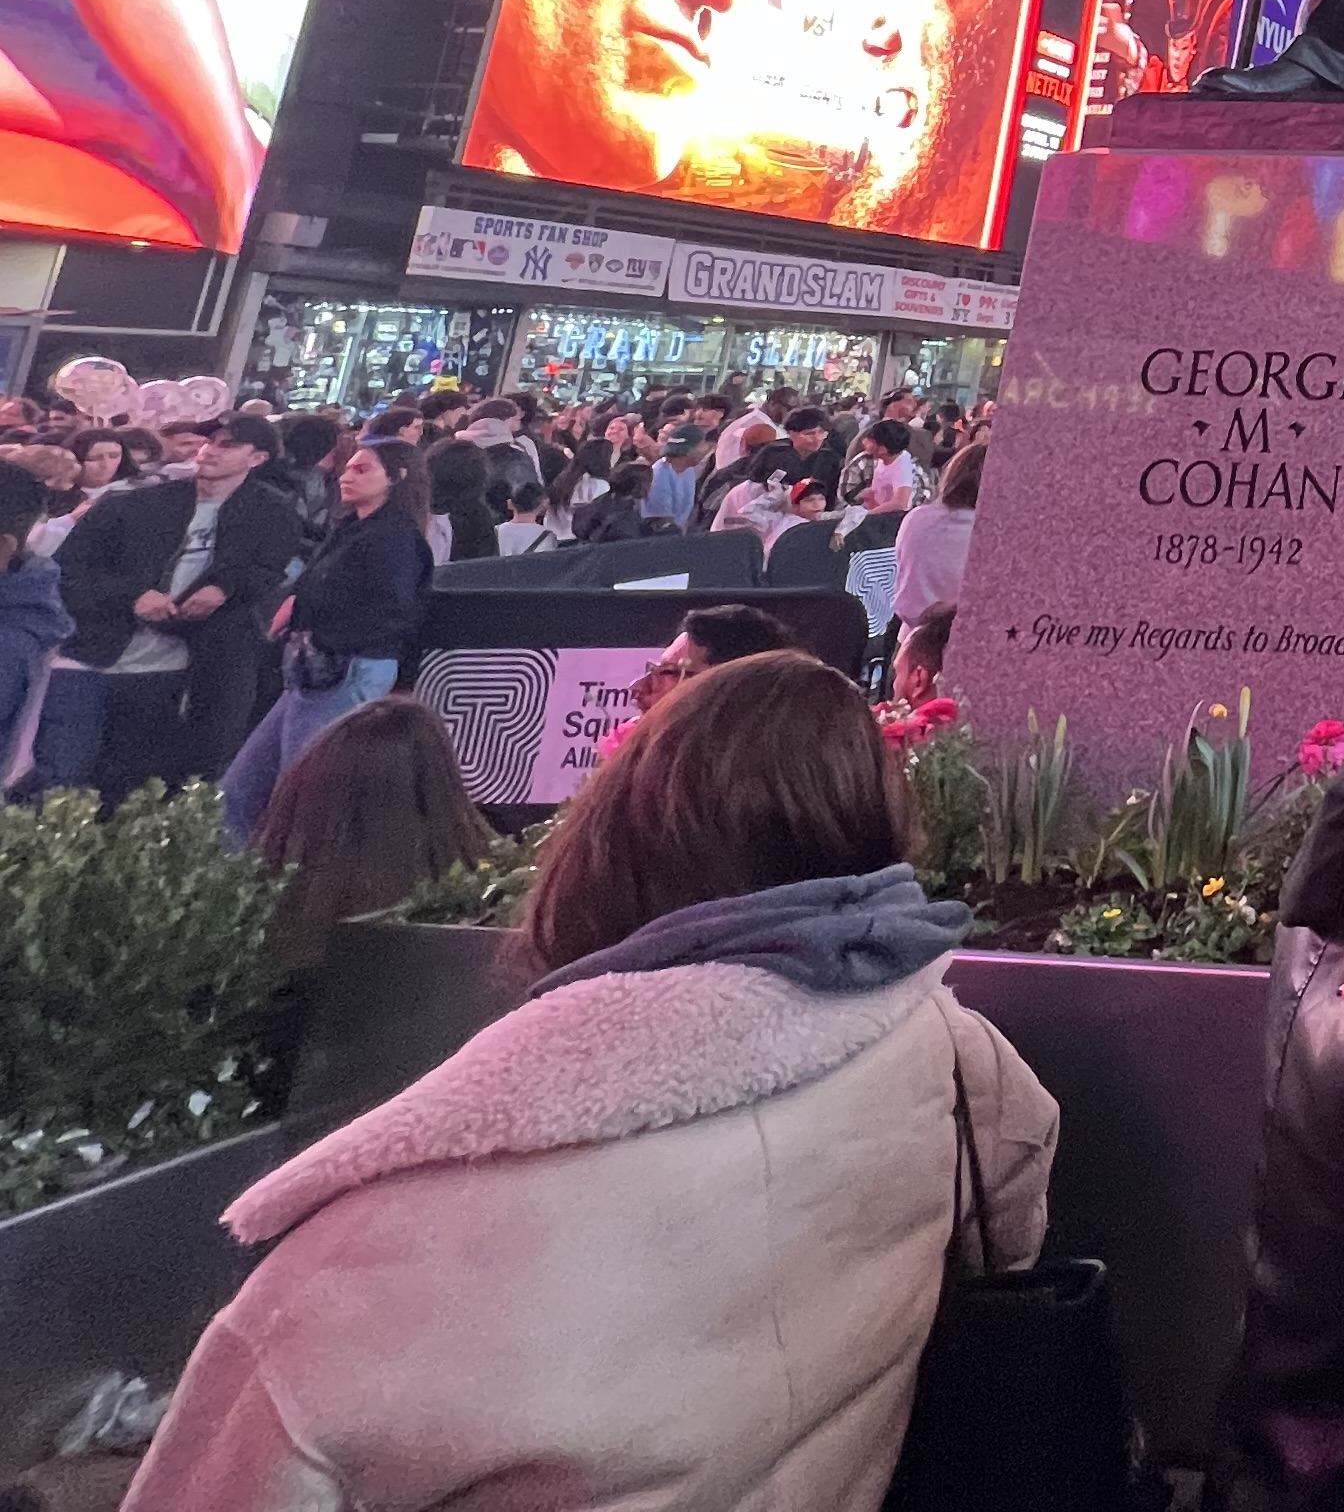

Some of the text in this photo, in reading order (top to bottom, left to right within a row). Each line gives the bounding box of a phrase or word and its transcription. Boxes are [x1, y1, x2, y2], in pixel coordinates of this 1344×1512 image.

[1026, 70, 1075, 107] NETFLIX
[473, 215, 609, 249] SPORTS FAN SHOP
[901, 276, 947, 291] DISCOUNT
[904, 289, 929, 301] GIFTS
[895, 301, 944, 316] SOUVENIRS
[557, 322, 687, 363] GRAND
[1219, 406, 1272, 454] M
[1139, 458, 1343, 514] COHAN
[1153, 532, 1304, 576] 1878-1942
[1027, 613, 1081, 654] Give
[1084, 623, 1127, 656] my
[1128, 619, 1238, 662] Regards
[1242, 624, 1270, 654] to
[579, 681, 640, 710] Tim
